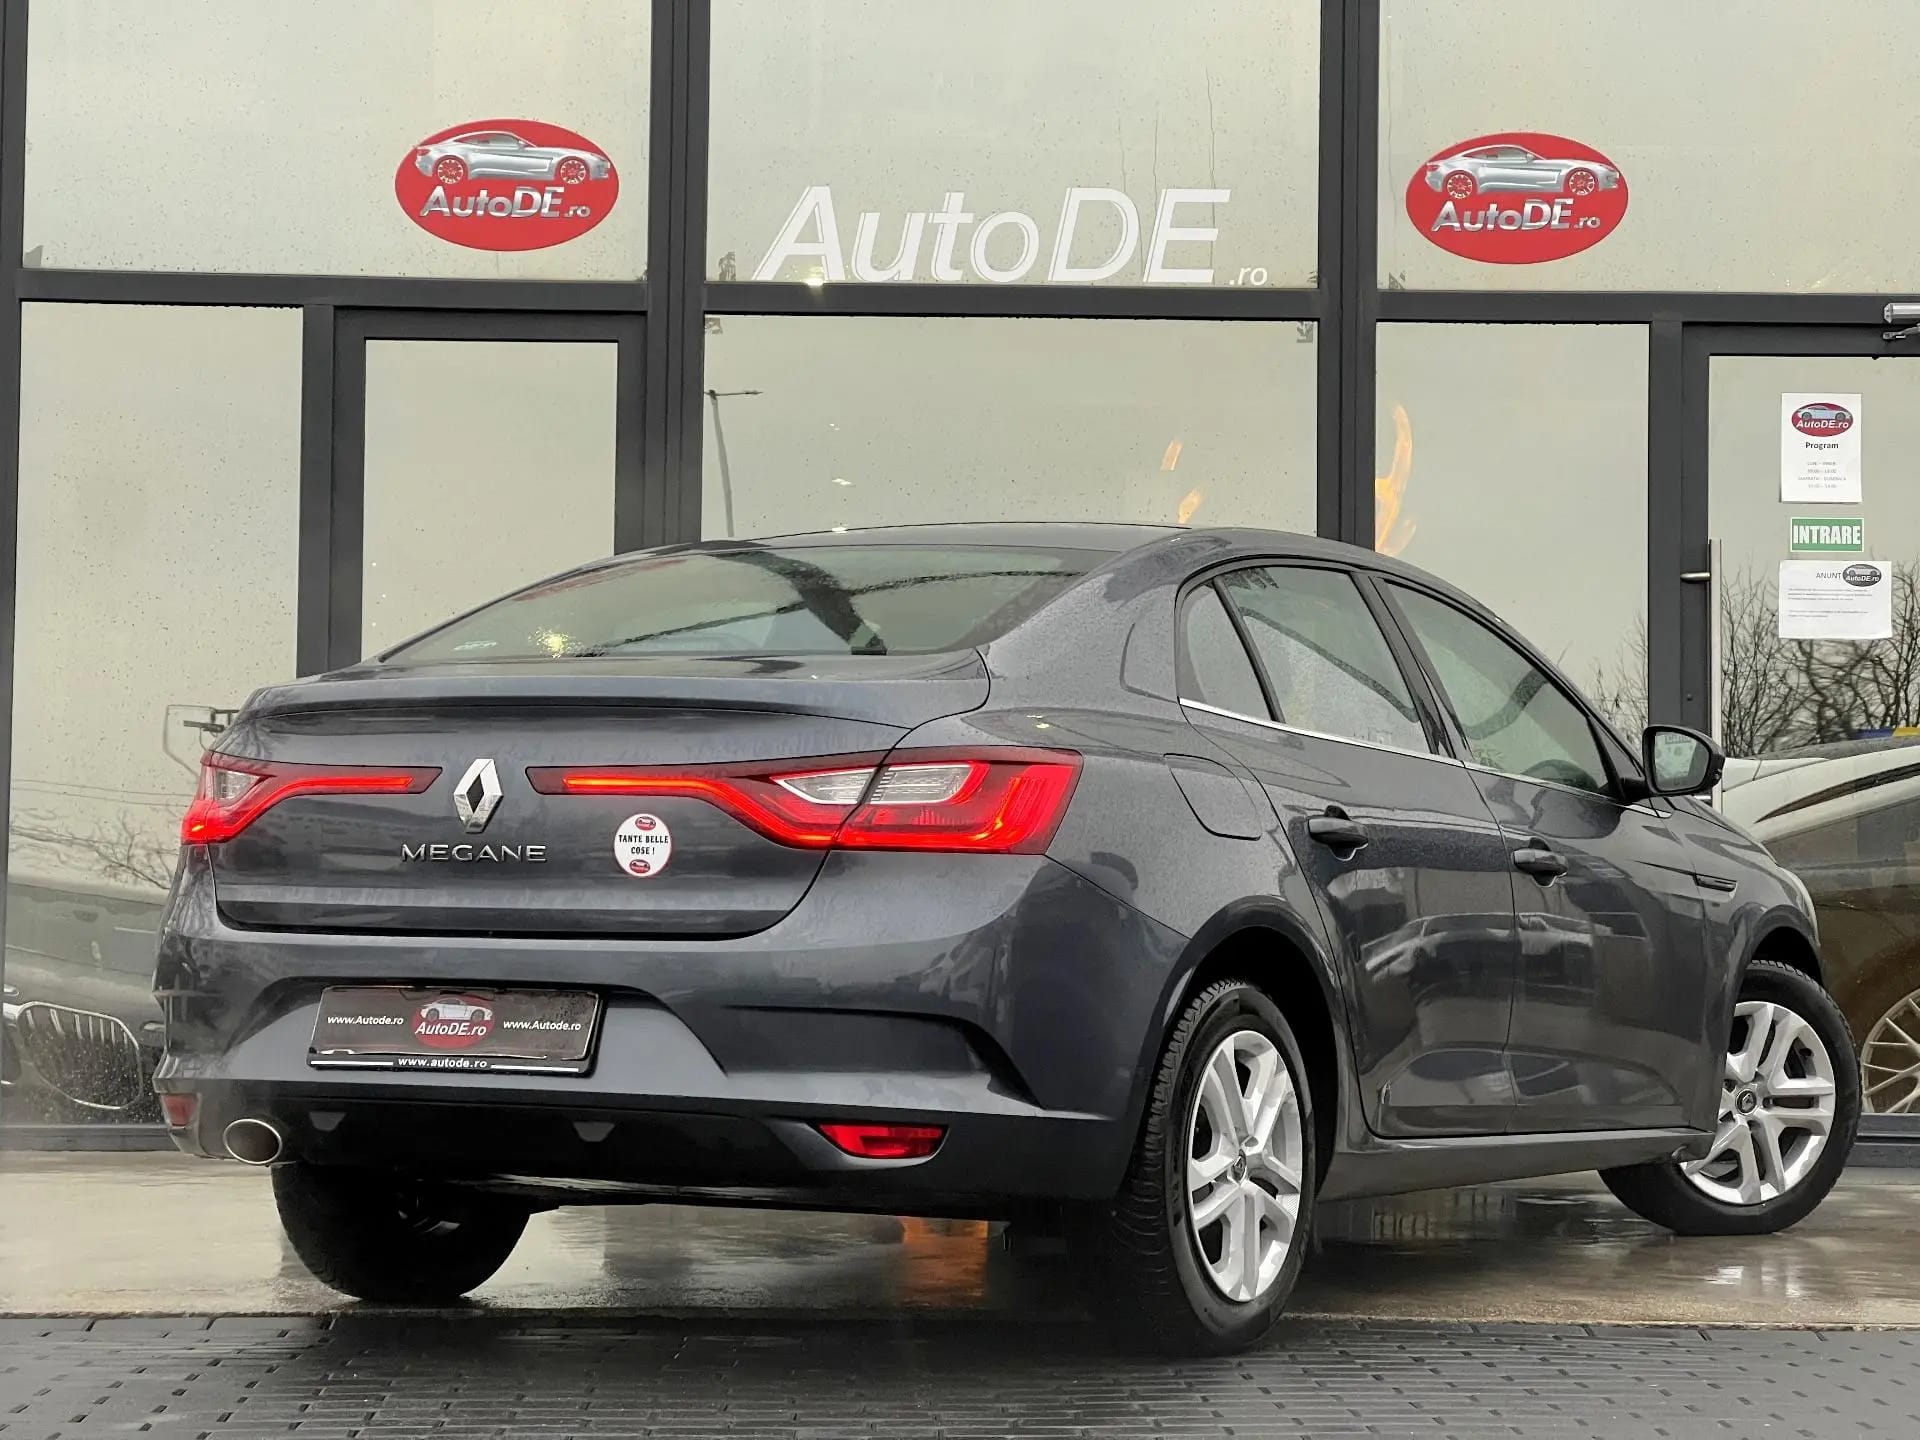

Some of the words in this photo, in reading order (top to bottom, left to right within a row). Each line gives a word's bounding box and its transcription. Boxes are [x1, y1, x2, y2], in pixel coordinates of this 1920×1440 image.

[1796, 420, 1849, 429] AutoDE.ro
[1805, 441, 1839, 451] Program
[1793, 525, 1861, 545] INTRARE
[618, 834, 643, 843] TANTE
[645, 835, 669, 844] BELLE
[401, 844, 547, 862] MEGANE
[630, 846, 650, 855] COSE
[327, 1014, 404, 1025] www.Autode.ro
[503, 1019, 582, 1031] www.Autode.ro
[414, 1021, 487, 1037] AutoDE.ro
[398, 1058, 488, 1069] www.autode.ro
